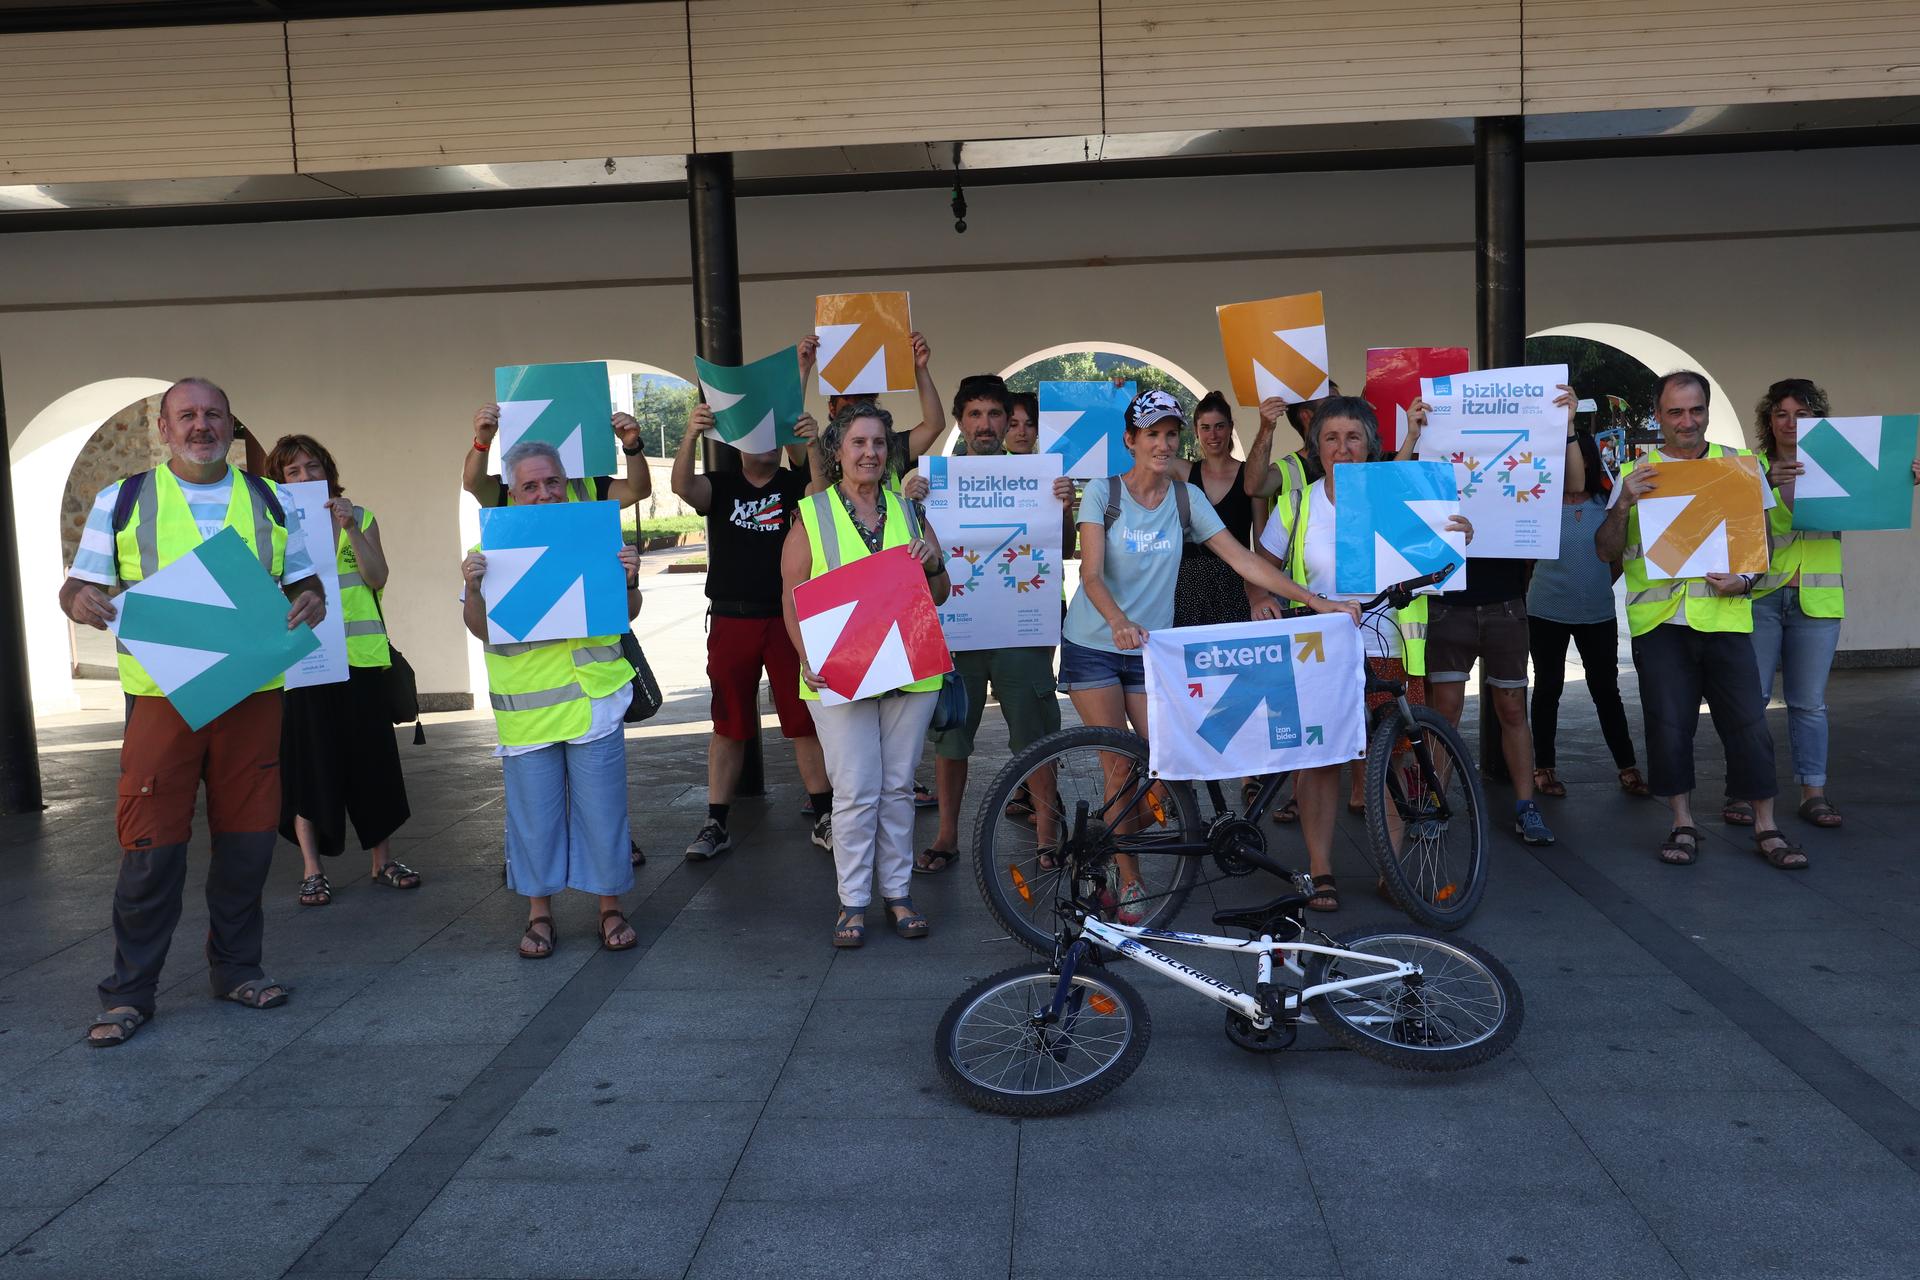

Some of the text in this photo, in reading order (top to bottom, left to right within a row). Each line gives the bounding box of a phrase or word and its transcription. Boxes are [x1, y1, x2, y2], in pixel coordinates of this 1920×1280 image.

[1462, 383, 1544, 398] bizikleta
[1434, 405, 1451, 413] 2022
[1462, 399, 1519, 415] itzulia
[958, 475, 1038, 492] bizikleta
[930, 499, 949, 507] 2022
[959, 492, 1015, 509] itzulia
[1194, 643, 1283, 669] etxera
[1276, 732, 1297, 741] bidea
[1144, 950, 1241, 997] ROCKRIDER
